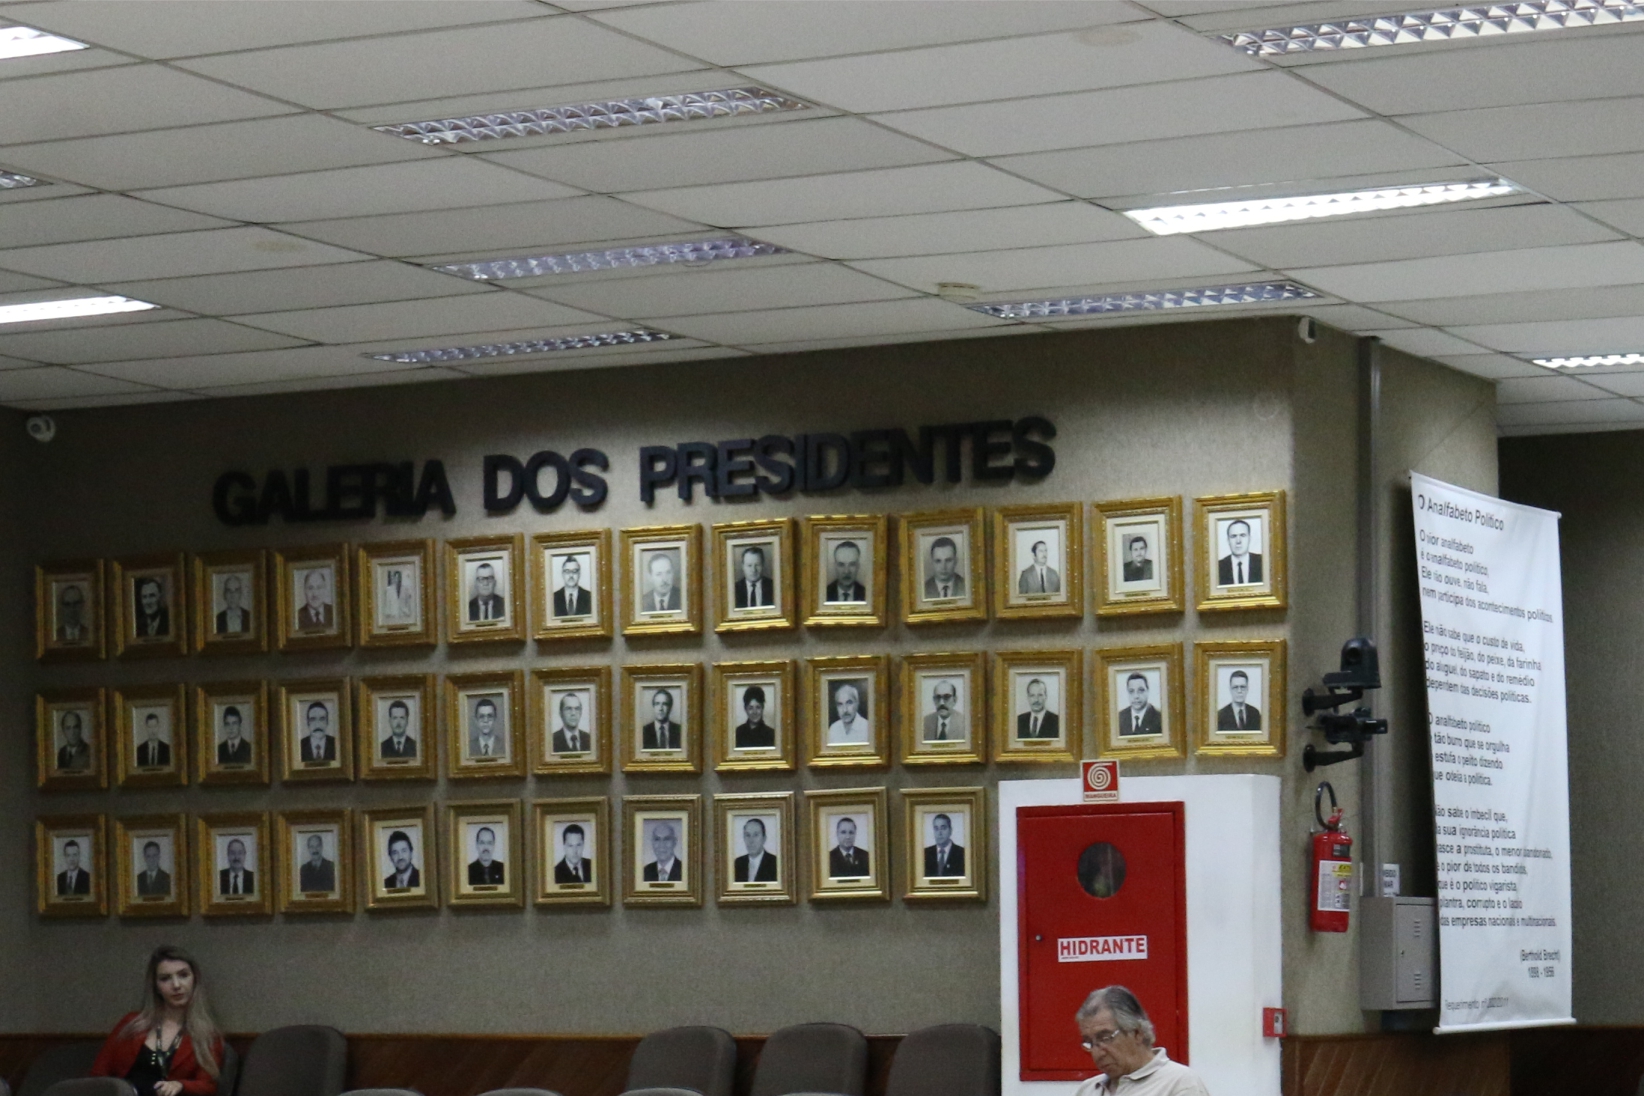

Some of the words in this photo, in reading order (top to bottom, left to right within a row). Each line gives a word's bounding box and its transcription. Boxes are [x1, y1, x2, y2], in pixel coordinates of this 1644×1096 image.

[213, 459, 456, 526] GALERIA
[484, 448, 609, 513] DOS
[640, 416, 1057, 504] PRESIDENTES
[1418, 495, 1425, 510] O
[1427, 498, 1473, 523] Analfabeto
[1475, 510, 1505, 531] Político
[1420, 530, 1425, 541] O
[1441, 538, 1474, 554] analfabeto
[1422, 566, 1432, 579] Ele
[1422, 587, 1436, 599] nem
[1424, 620, 1434, 634] Ele
[1462, 632, 1474, 646] que
[1476, 635, 1481, 643] o
[1482, 635, 1499, 647] custo
[1501, 637, 1508, 650] de
[1507, 656, 1515, 668] da
[1491, 672, 1495, 682] e
[1496, 671, 1504, 683] do
[1464, 738, 1476, 751] que
[1477, 742, 1484, 751] se
[1465, 810, 1469, 819] o
[1443, 826, 1456, 836] sua
[1456, 844, 1461, 854] a
[1495, 847, 1500, 857] o
[1446, 862, 1461, 875] pior
[1492, 864, 1499, 874] os
[1456, 880, 1461, 890] o
[1497, 900, 1501, 909] e
[1503, 900, 1507, 909] o
[1451, 916, 1487, 928] empresas
[1060, 938, 1145, 956] HIDRANTE
